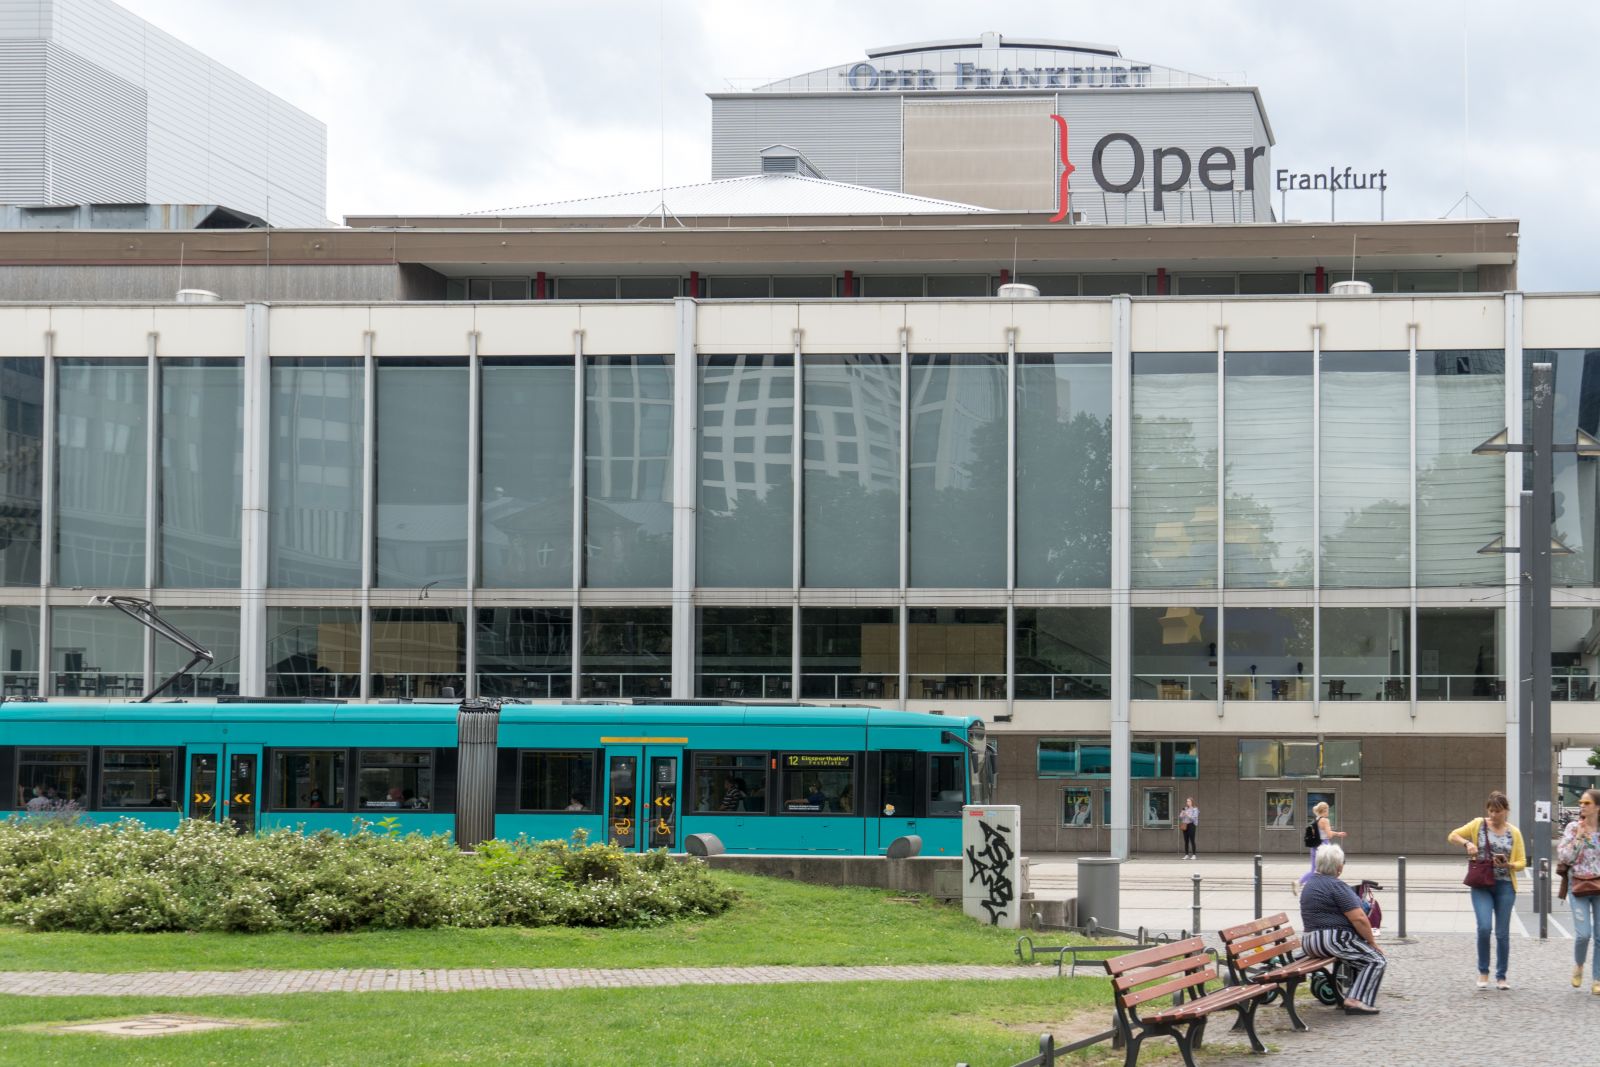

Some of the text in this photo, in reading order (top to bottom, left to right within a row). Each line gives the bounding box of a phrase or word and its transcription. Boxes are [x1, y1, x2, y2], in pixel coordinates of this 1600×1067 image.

[1092, 132, 1387, 211] Oper Frankfurt
[788, 755, 799, 766] 12
